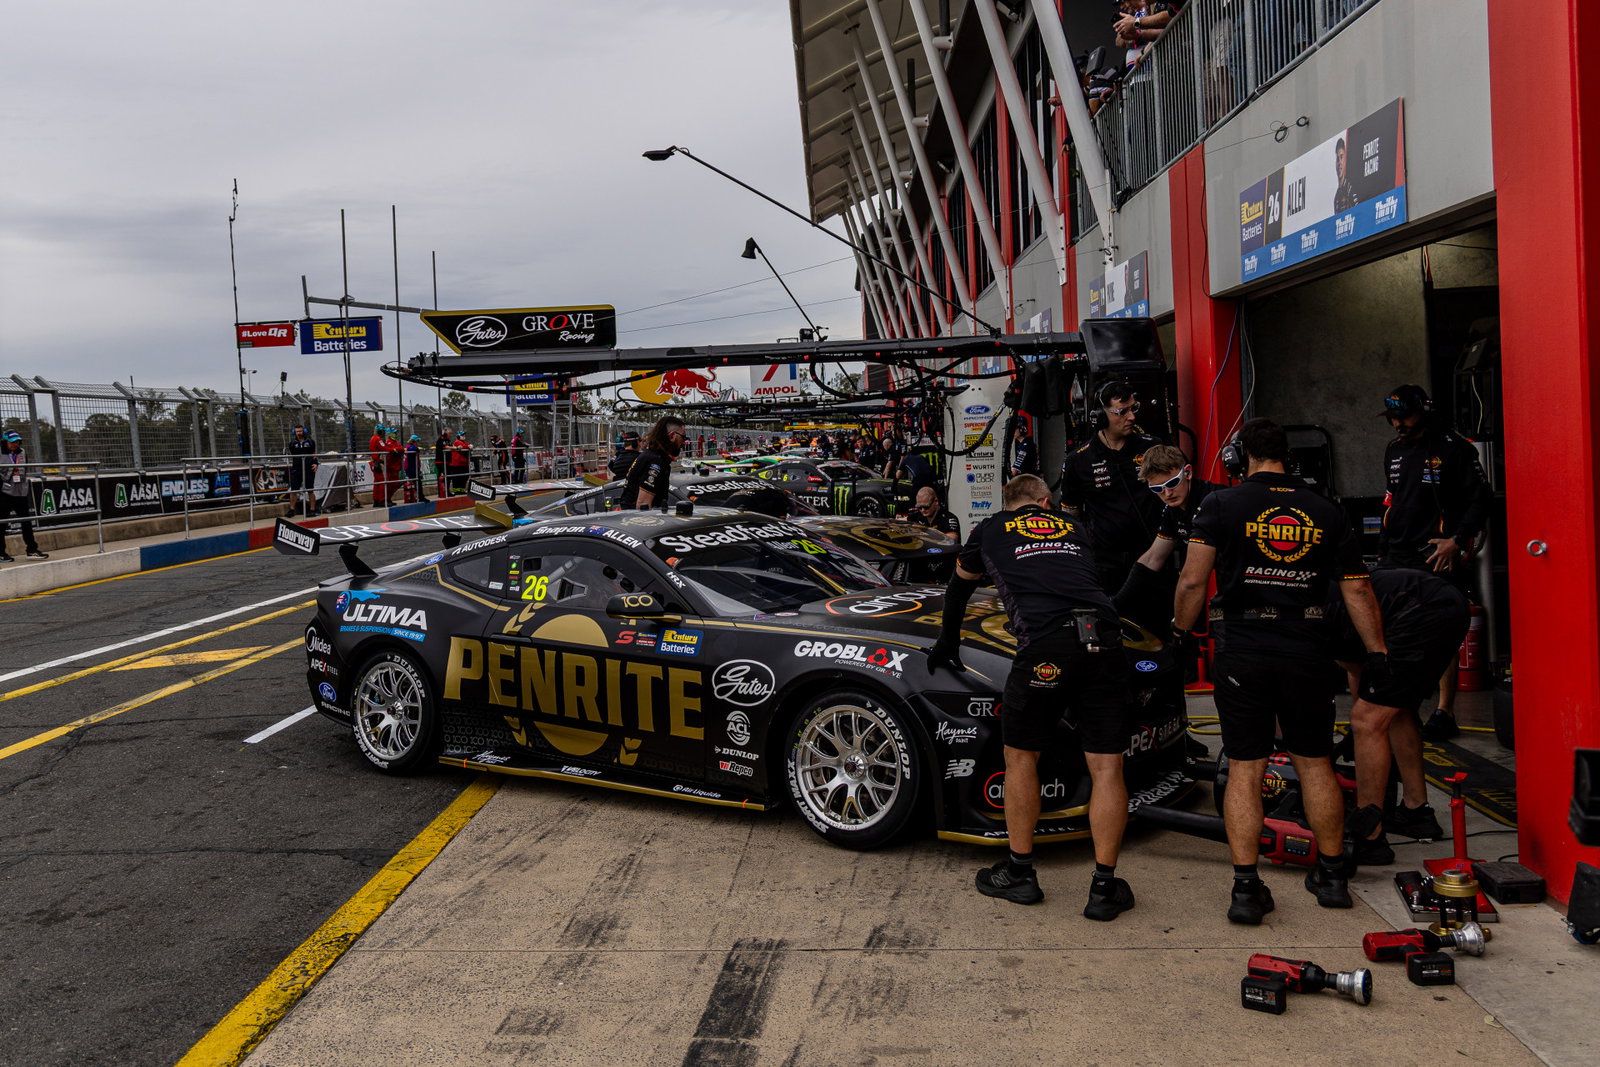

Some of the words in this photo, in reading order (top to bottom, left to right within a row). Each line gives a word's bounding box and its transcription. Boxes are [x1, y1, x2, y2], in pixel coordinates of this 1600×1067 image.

[1287, 176, 1306, 217] ALLEN
[1268, 191, 1280, 225] 26
[1376, 195, 1398, 220] Thrifty
[1242, 222, 1262, 242] Batteries
[1336, 213, 1355, 236] Thrifty
[522, 313, 595, 331] GROVE
[242, 330, 267, 338] #Love
[458, 320, 505, 345] Gates
[558, 331, 595, 342] Racing
[755, 386, 797, 395] AMPOL
[59, 487, 94, 508] AASA
[130, 483, 159, 501] AASA
[161, 478, 209, 497] ENDLESS
[687, 480, 763, 495] Steadfast
[971, 501, 992, 509] Thrifty
[277, 522, 317, 549] Floorway
[313, 515, 482, 541] GROVE
[532, 526, 586, 536] Snap-on
[1004, 520, 1076, 533] PENRITE
[1245, 521, 1323, 544] PENRITE
[461, 534, 508, 553] AUTODESK
[602, 529, 642, 549] ALLEN
[658, 522, 795, 553] Steadfast
[790, 538, 828, 554] 26
[1014, 542, 1062, 553] RACING
[666, 571, 686, 588] HRX
[1245, 566, 1296, 578] RACING
[521, 575, 549, 601] 26
[621, 595, 653, 608] 100
[342, 603, 427, 630] ULTIMA
[394, 629, 410, 637] SINCE
[663, 630, 698, 644] Century
[309, 633, 331, 654] Midea
[660, 642, 695, 654] Batteries
[795, 640, 909, 671] GROBLOX
[392, 654, 426, 699] DUNLOP
[834, 658, 865, 670] POWERED
[866, 663, 875, 671] BY
[875, 665, 901, 679] GROVE
[443, 636, 704, 740] PENRITE
[714, 666, 772, 700] Gates
[726, 723, 750, 735] ACL
[936, 721, 977, 745] Haymes
[874, 706, 911, 780] DUNLOP
[721, 747, 759, 761] DUNLOP
[729, 764, 753, 777] Repco
[788, 758, 802, 801] MAXX
[797, 799, 830, 834] SPORT
